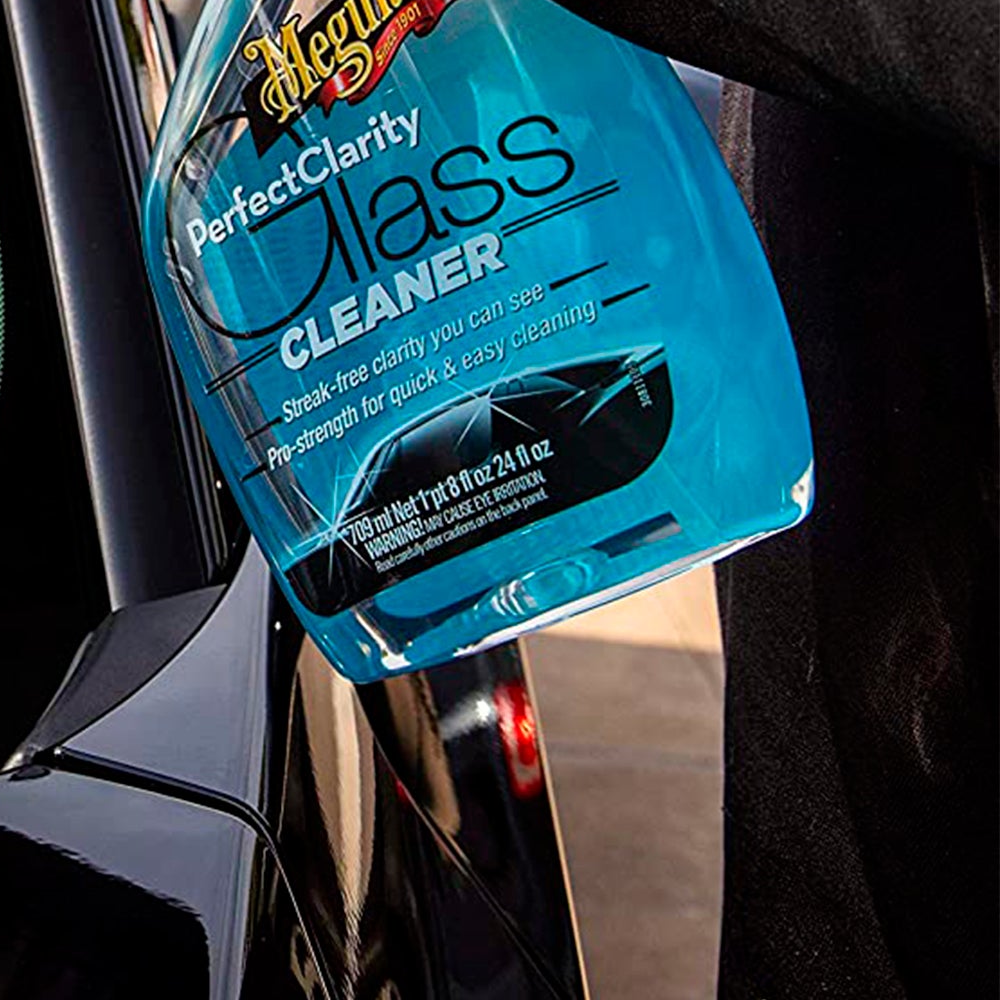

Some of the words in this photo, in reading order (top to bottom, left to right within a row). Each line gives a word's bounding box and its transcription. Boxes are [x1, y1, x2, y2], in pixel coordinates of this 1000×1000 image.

[375, 24, 398, 67] Since
[397, 3, 423, 33] 1901
[165, 109, 576, 341] Glass
[279, 232, 508, 372] CLEANER
[281, 363, 369, 424] Streak-free
[372, 335, 426, 376] clarity
[430, 317, 465, 351] you
[469, 300, 504, 330] can
[509, 283, 545, 312] see
[266, 405, 360, 472] Pro-strength
[361, 392, 385, 419] for
[389, 366, 440, 407] quick
[443, 356, 458, 381] &
[462, 336, 505, 370] easy
[511, 300, 597, 349] cleaning
[348, 516, 375, 546] 709
[373, 506, 395, 534] ml
[391, 495, 420, 524] Net
[418, 488, 431, 511] 1
[430, 481, 450, 511] pt
[446, 475, 461, 498] 8
[459, 468, 475, 493] fl
[473, 464, 496, 487] oz
[492, 449, 517, 478] 24
[515, 443, 532, 468] fl
[530, 439, 555, 462] oz
[363, 516, 427, 560] WARNING!
[443, 498, 477, 525] CAUSE
[472, 490, 496, 512] EYE
